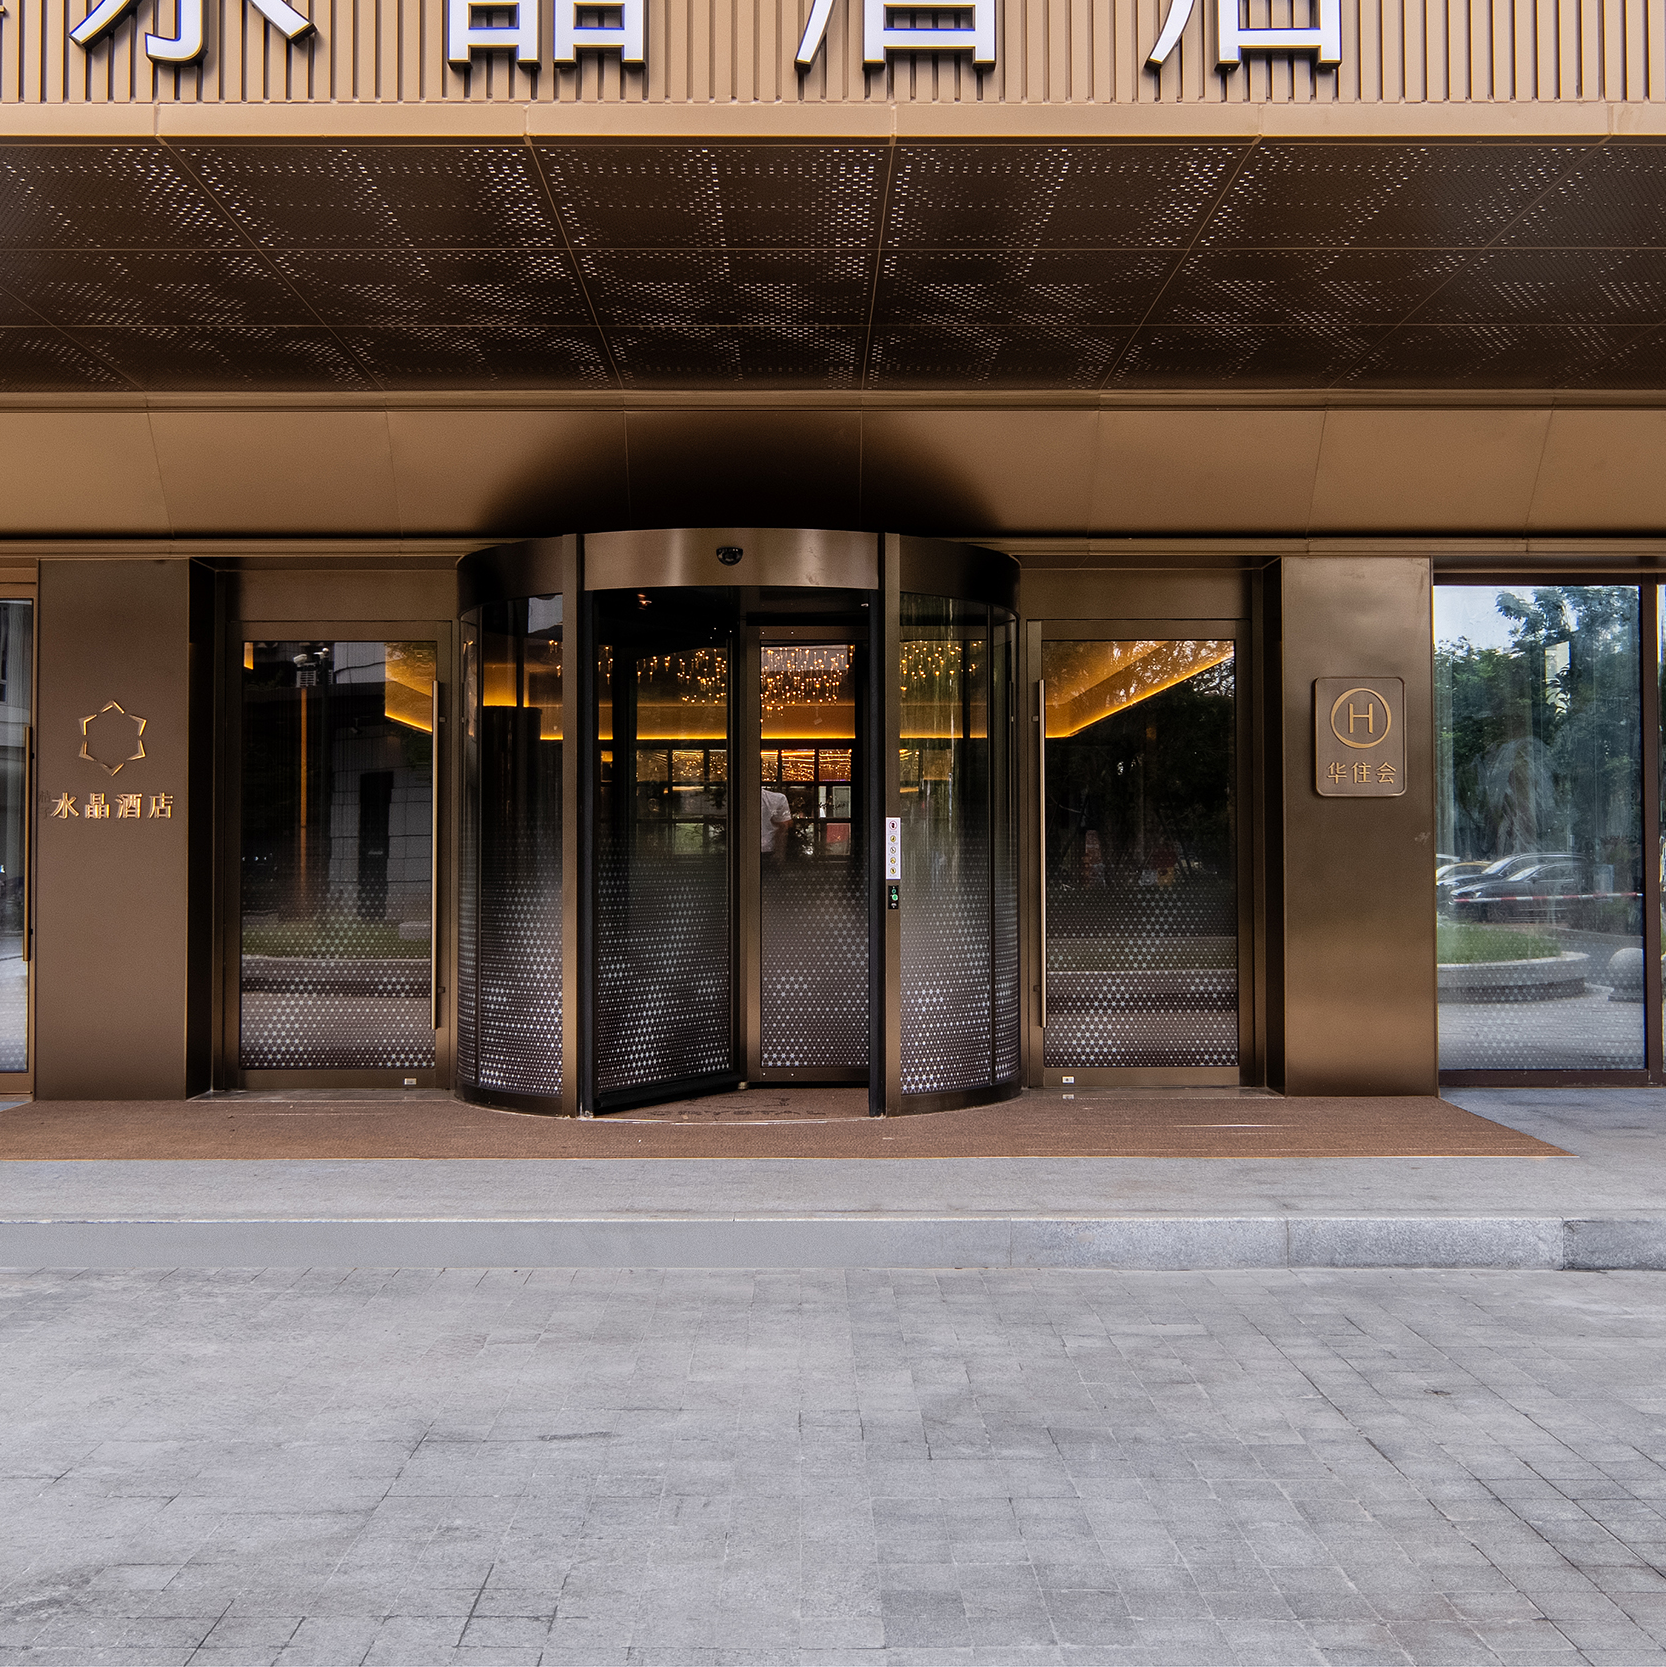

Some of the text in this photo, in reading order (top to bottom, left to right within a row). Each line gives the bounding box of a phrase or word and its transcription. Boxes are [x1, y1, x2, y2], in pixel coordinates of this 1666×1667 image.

[1327, 761, 1397, 785] 华住会
[50, 791, 175, 820] 水晶酒店
